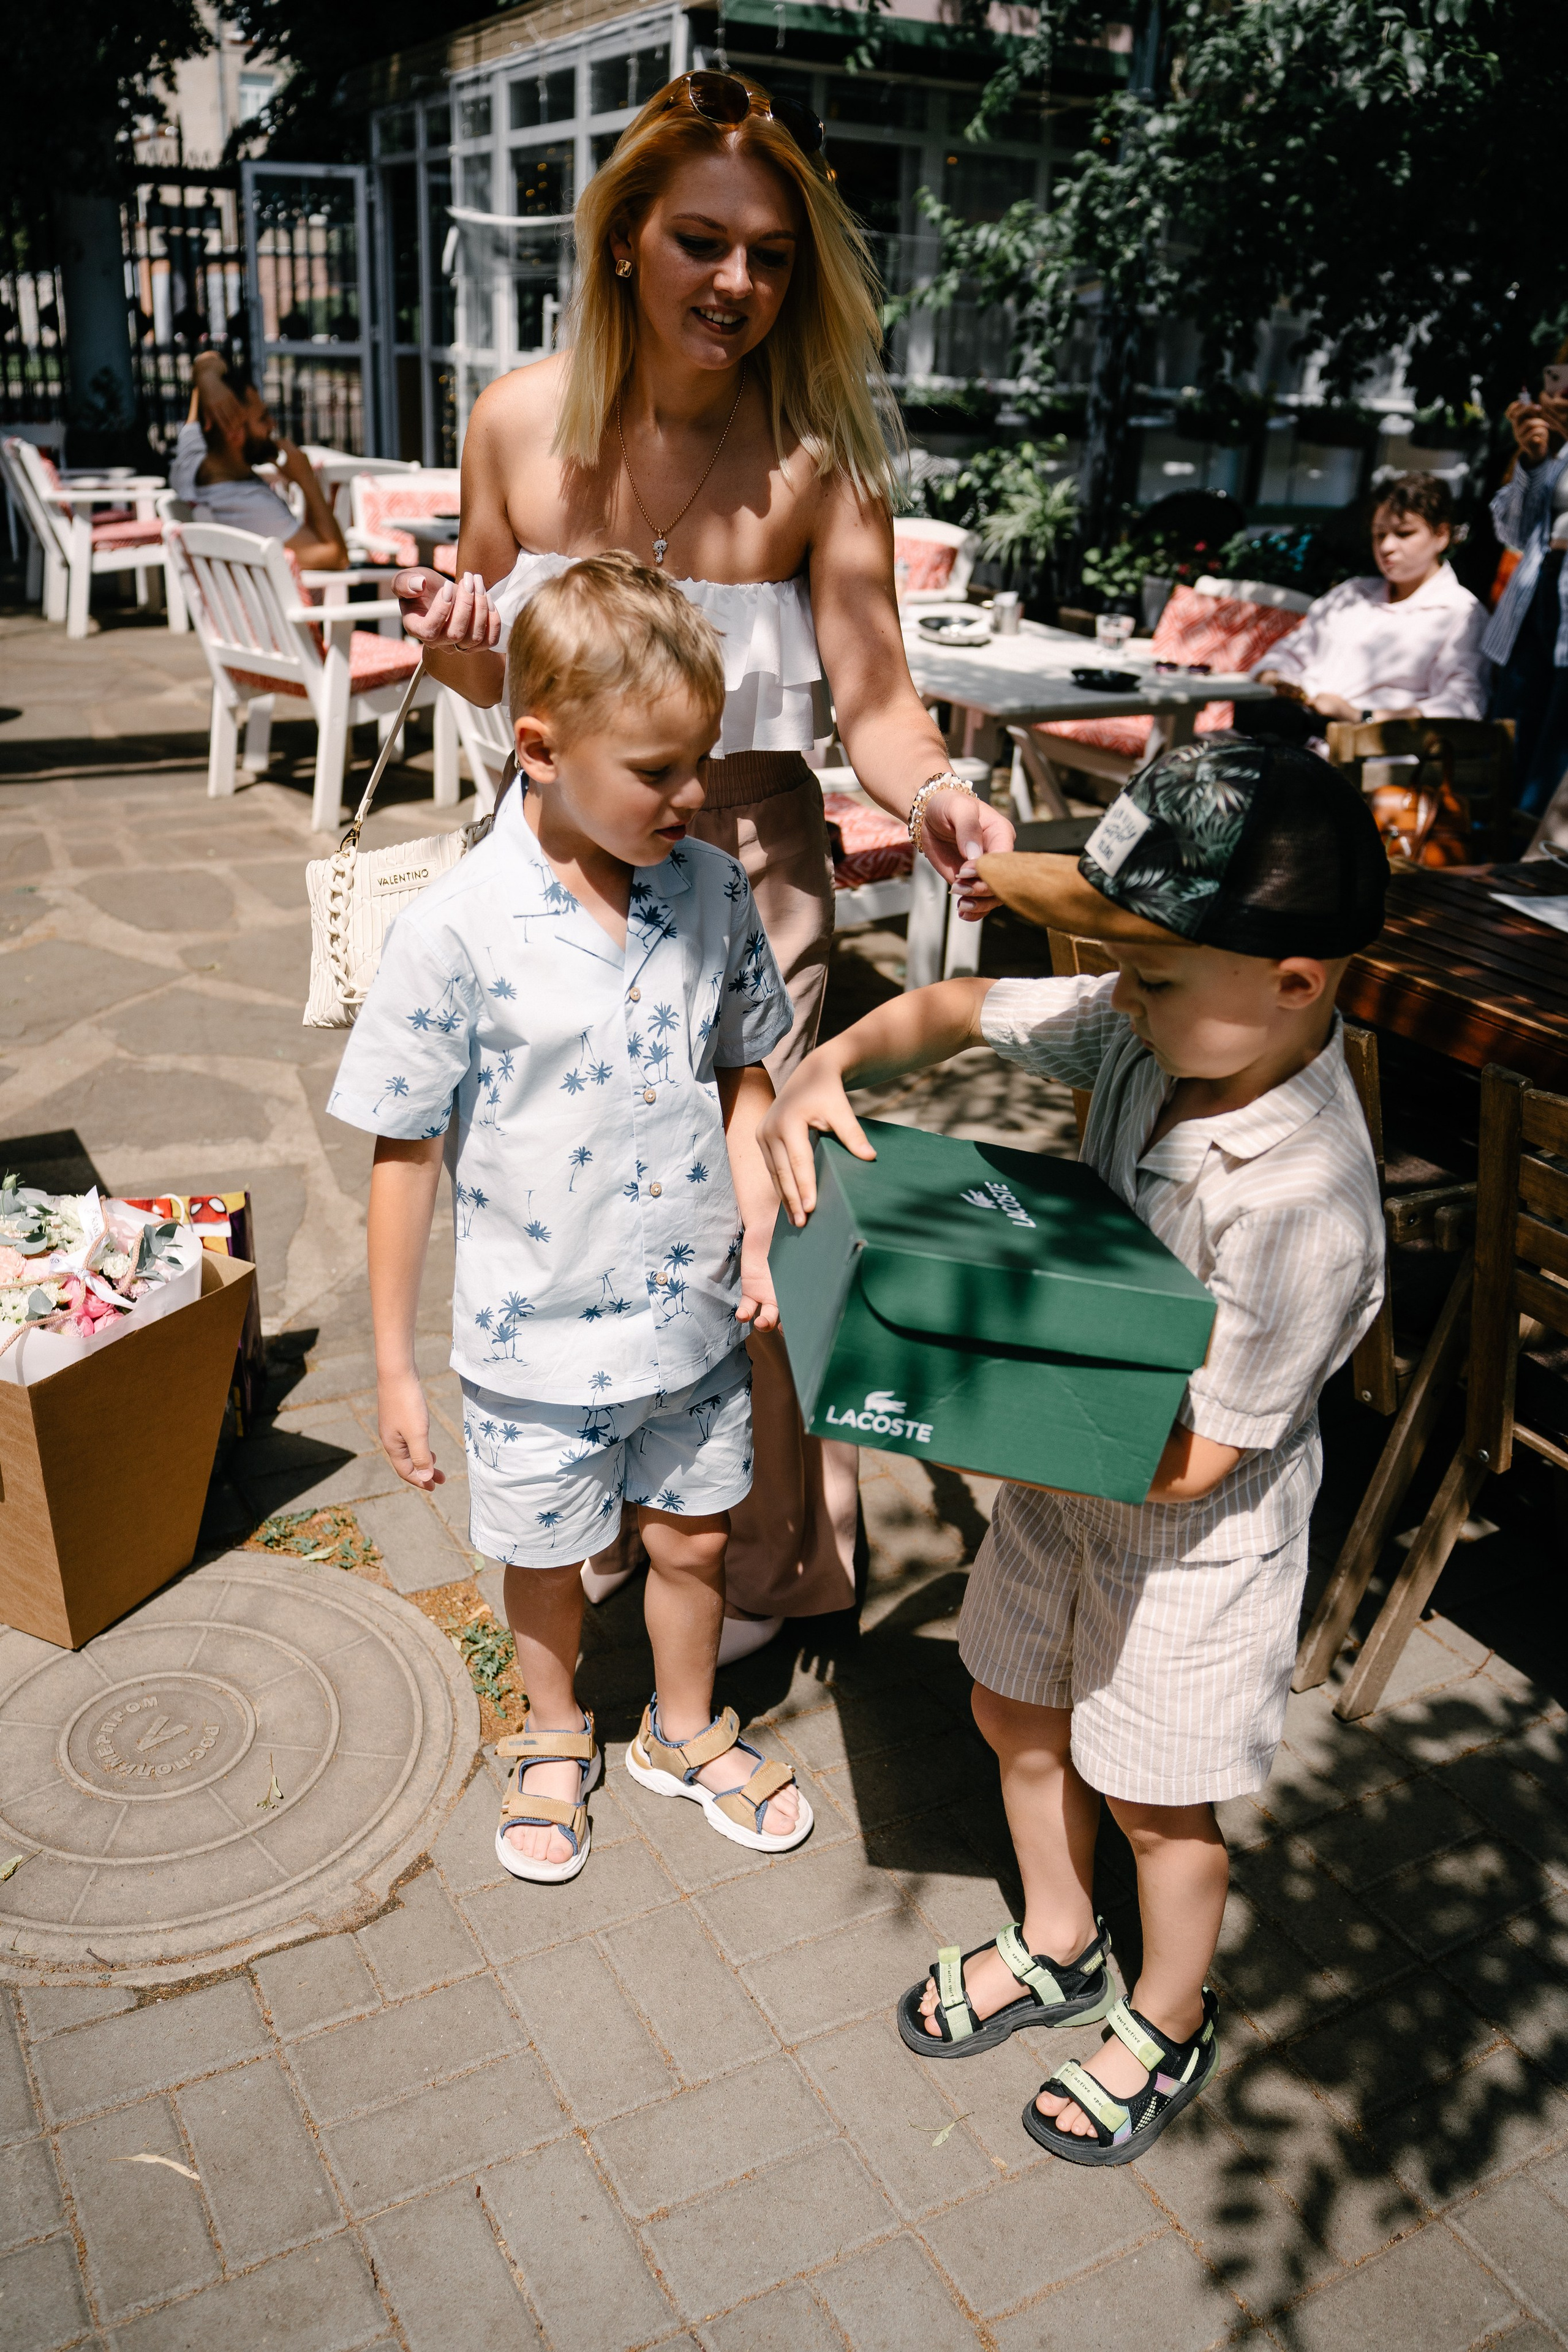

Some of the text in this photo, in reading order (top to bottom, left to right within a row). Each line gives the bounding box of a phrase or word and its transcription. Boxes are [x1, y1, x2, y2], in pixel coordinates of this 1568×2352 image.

[377, 869, 429, 887] VALENTINO
[984, 1181, 1036, 1228] LACOSTE
[826, 1405, 934, 1443] LACOSTE
[1012, 1953, 1024, 1966] sport
[1117, 2015, 1140, 2043] sport active
[1074, 2076, 1090, 2094] active
